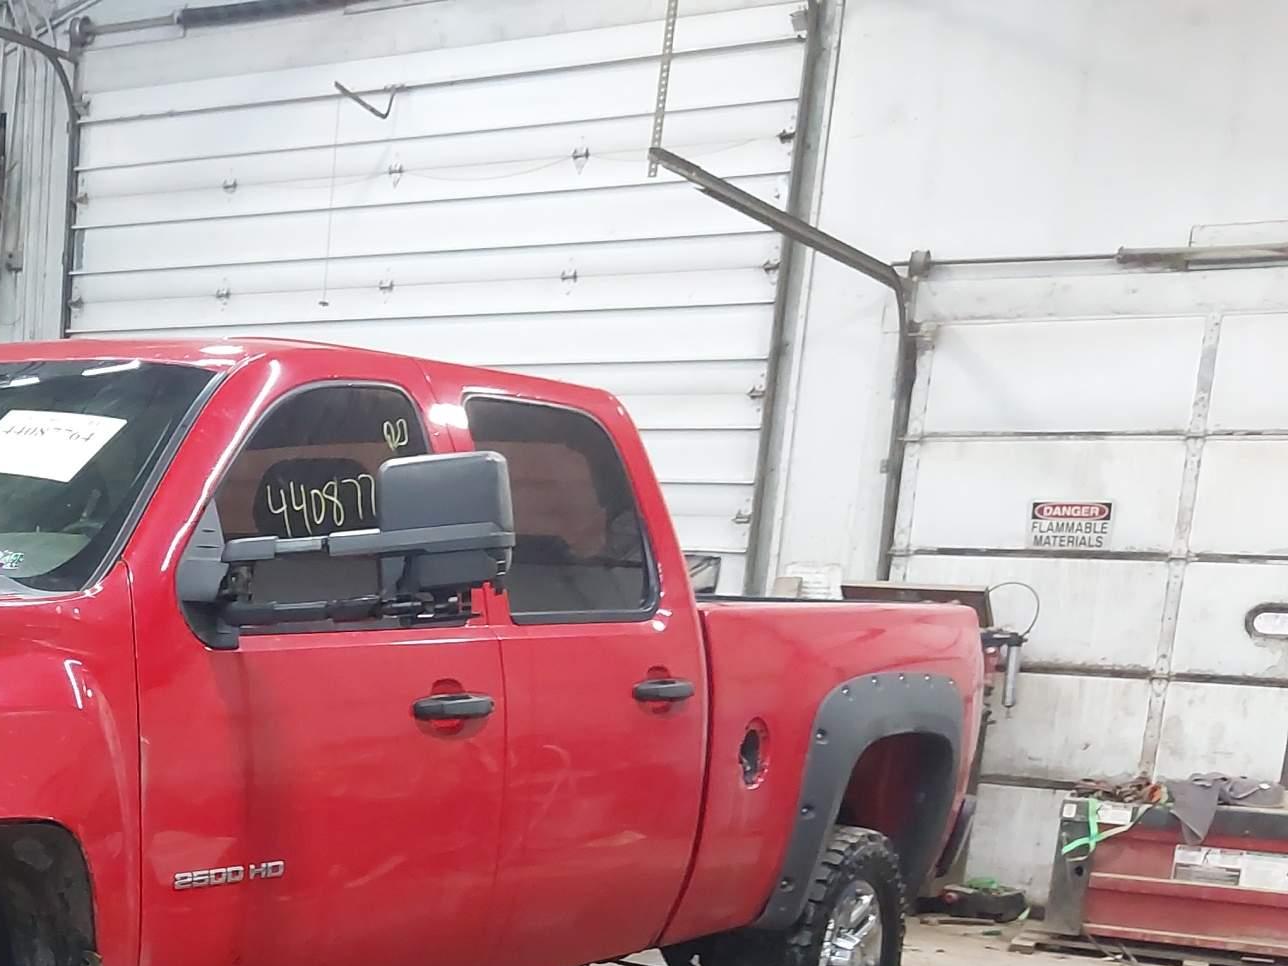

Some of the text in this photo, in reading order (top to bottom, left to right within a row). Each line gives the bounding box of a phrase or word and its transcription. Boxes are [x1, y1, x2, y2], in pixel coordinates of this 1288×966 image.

[1042, 505, 1100, 517] DANGER
[1031, 521, 1109, 534] FLAMMABLE
[1033, 535, 1104, 548] MATERIALS
[174, 860, 284, 890] 2500 HD
